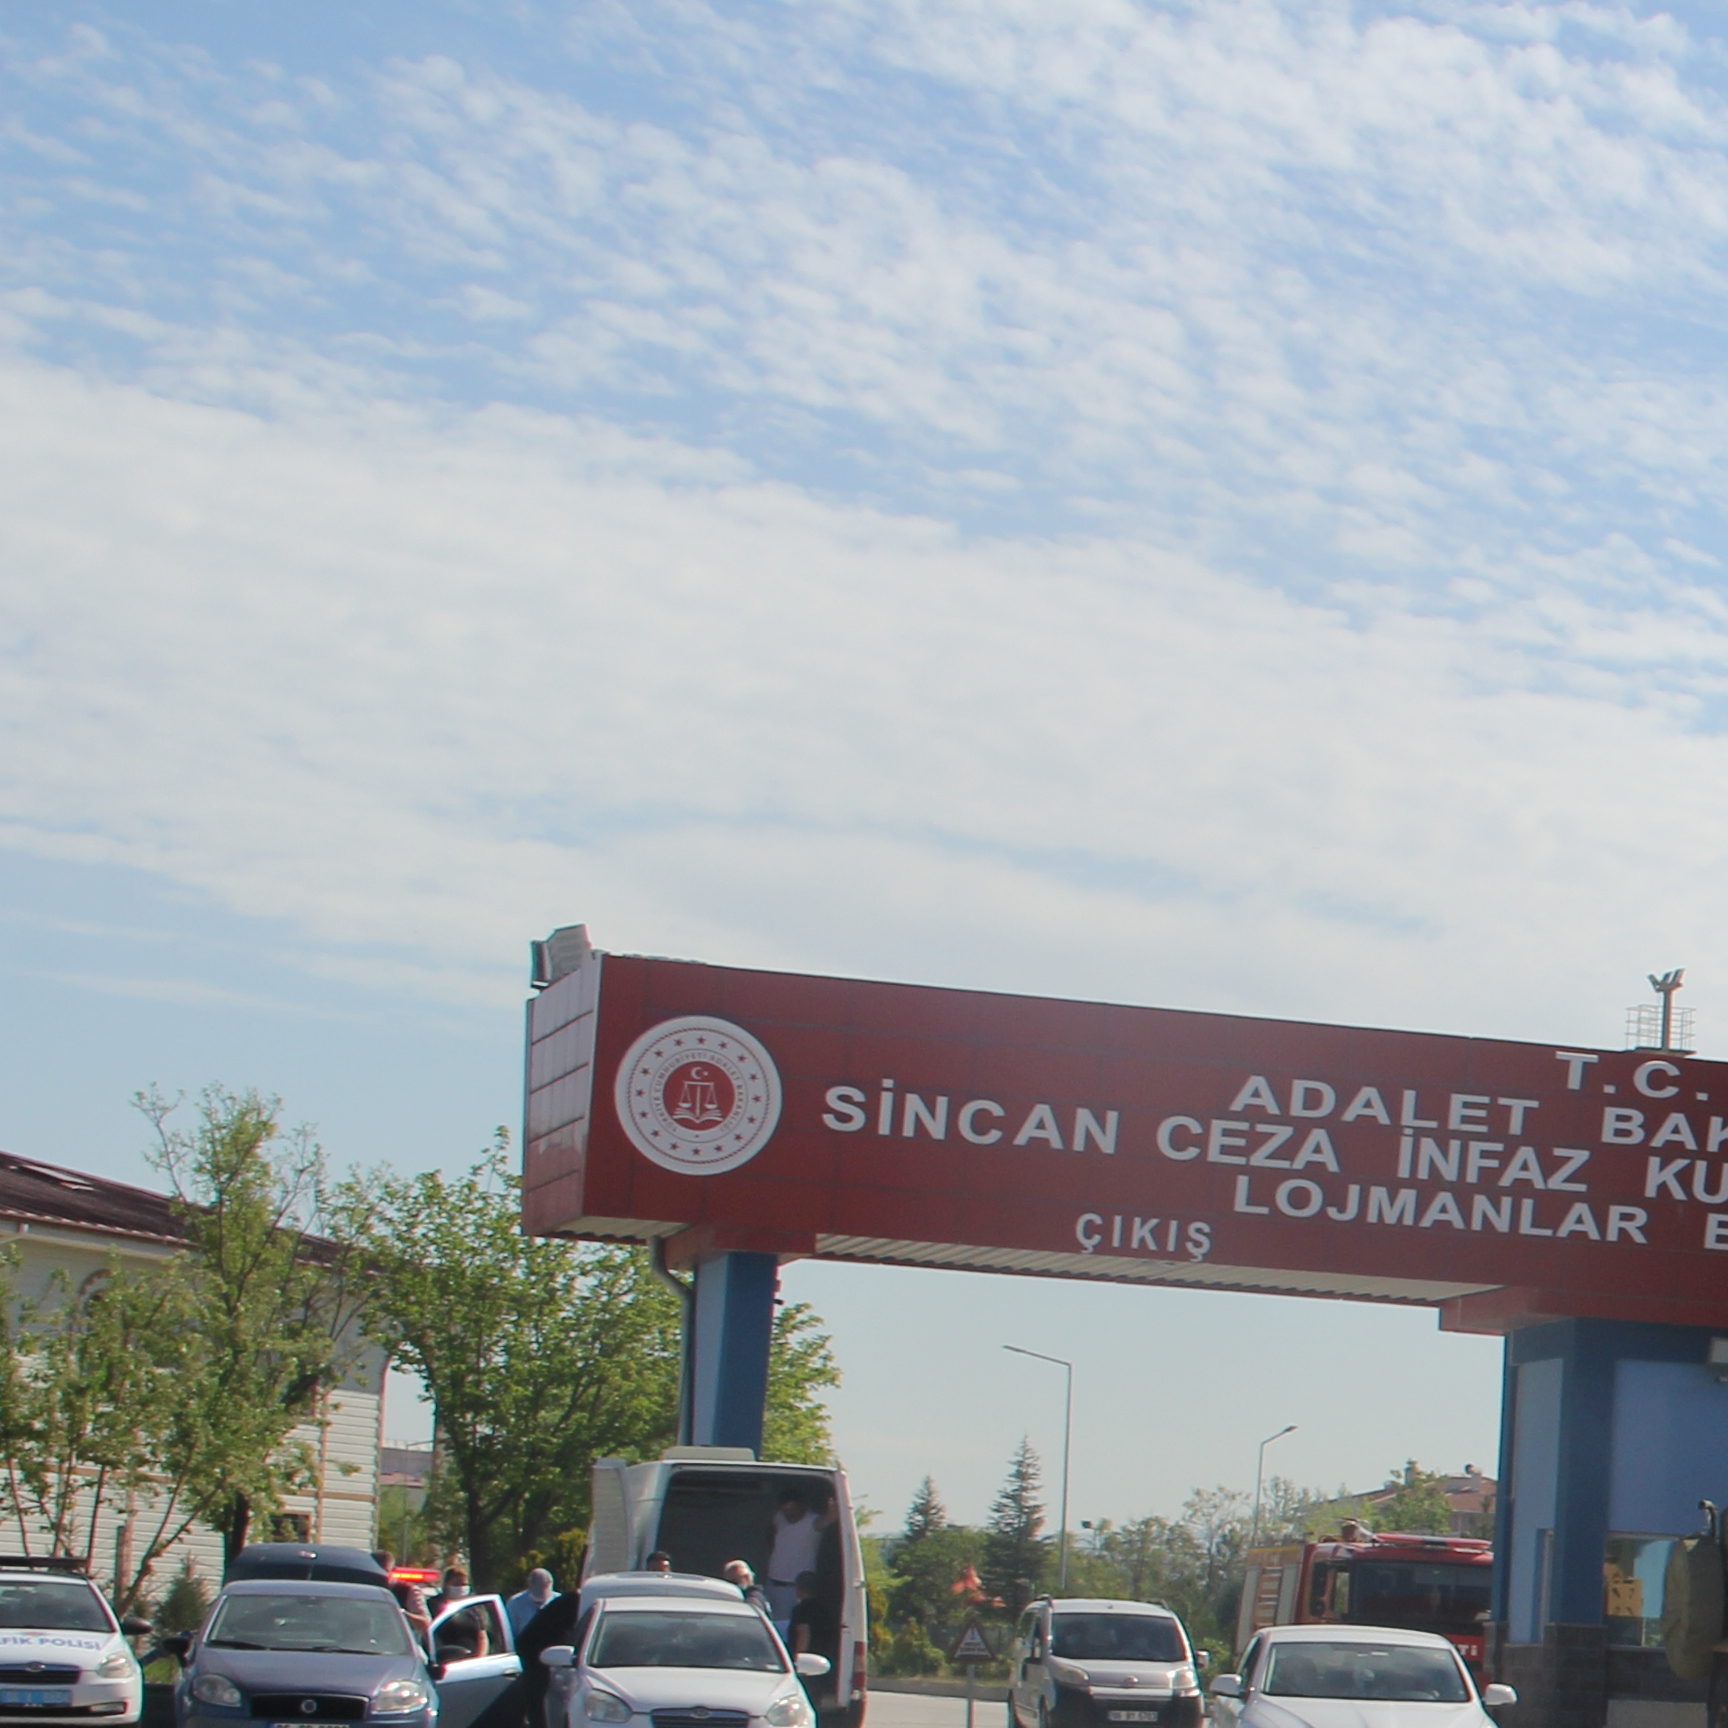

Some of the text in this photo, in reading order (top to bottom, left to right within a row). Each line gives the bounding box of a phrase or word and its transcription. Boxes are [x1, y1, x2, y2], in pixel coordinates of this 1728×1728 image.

[1228, 1074, 1540, 1136] ADALET
[1555, 1050, 1710, 1101] T.C.
[821, 1078, 1119, 1154] SİNCAN
[1156, 1115, 1341, 1173] CEZA
[1398, 1128, 1592, 1192] İNFAZ
[1074, 1213, 1213, 1263] ÇIKIŞ
[1233, 1174, 1649, 1245] LOJMANLAR
